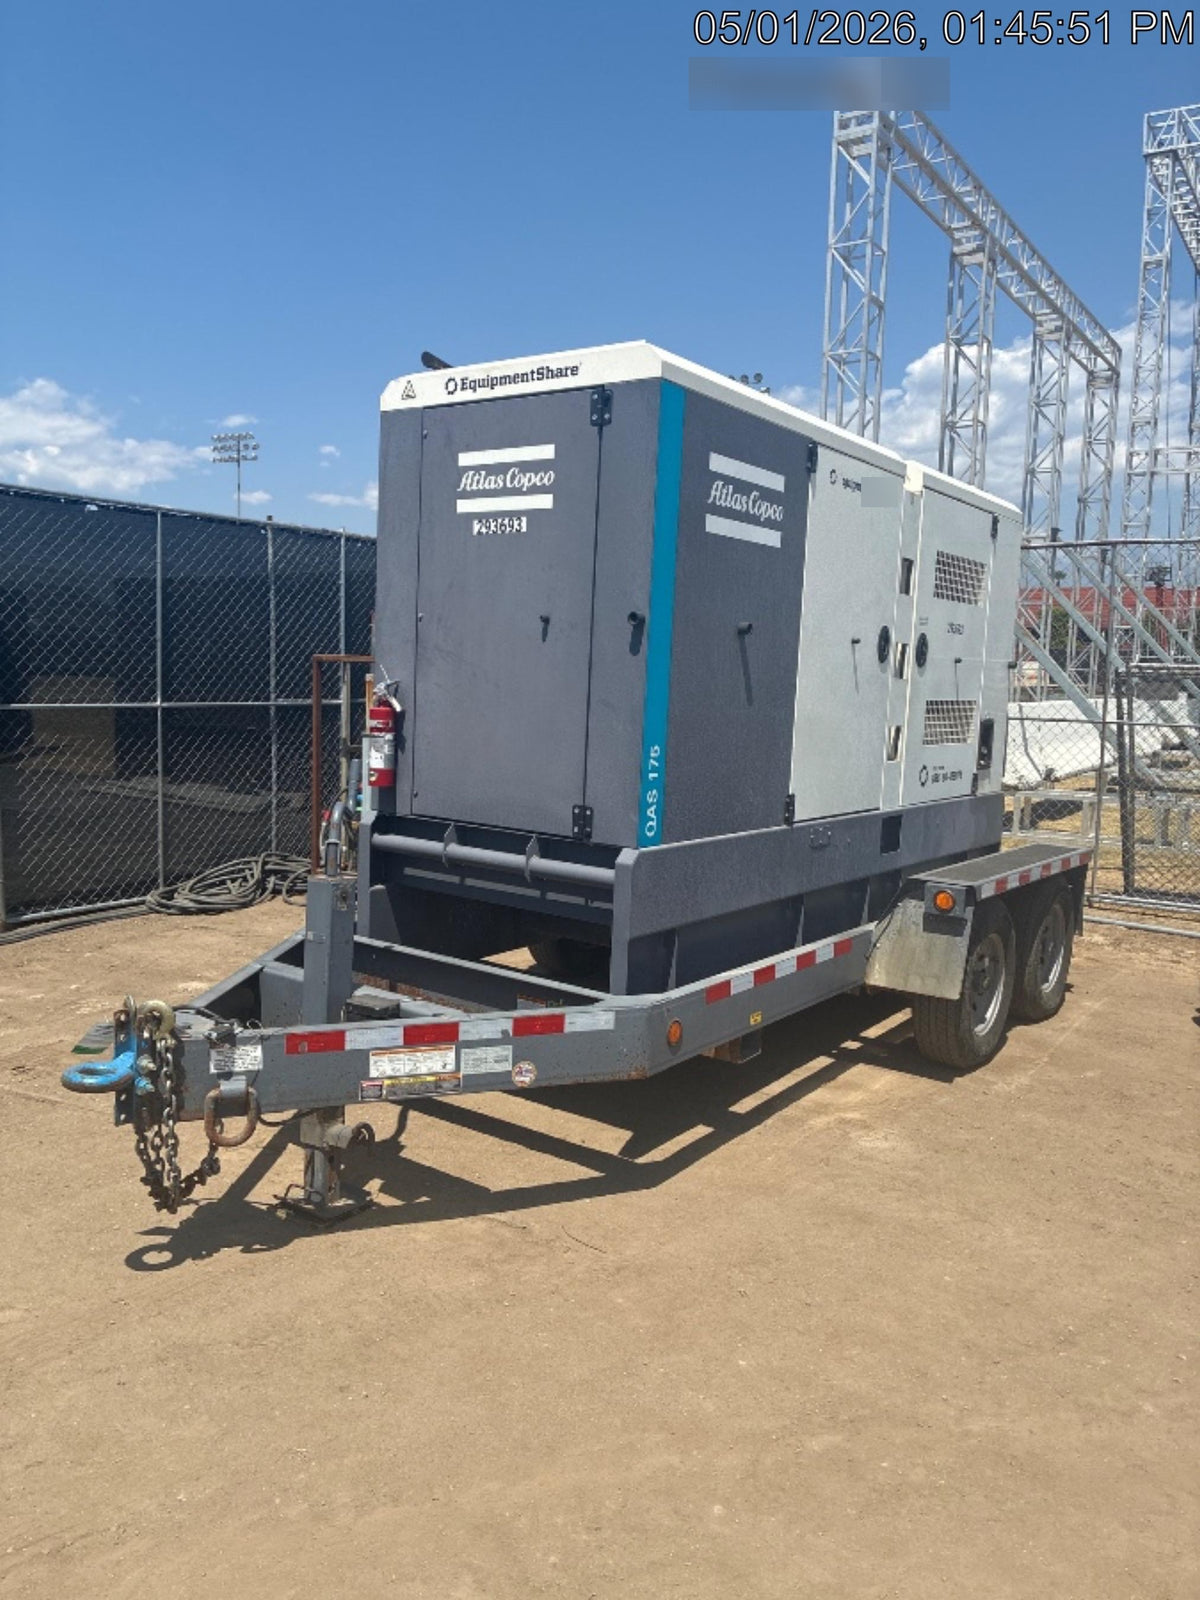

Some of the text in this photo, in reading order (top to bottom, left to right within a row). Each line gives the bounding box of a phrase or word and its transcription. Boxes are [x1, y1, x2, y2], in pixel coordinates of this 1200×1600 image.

[460, 364, 580, 393] EquipmentShare
[457, 467, 555, 491] Atlas Copco
[707, 480, 783, 521] Atlas Copco
[476, 516, 523, 535] 293693
[645, 744, 661, 837] QAS 175
